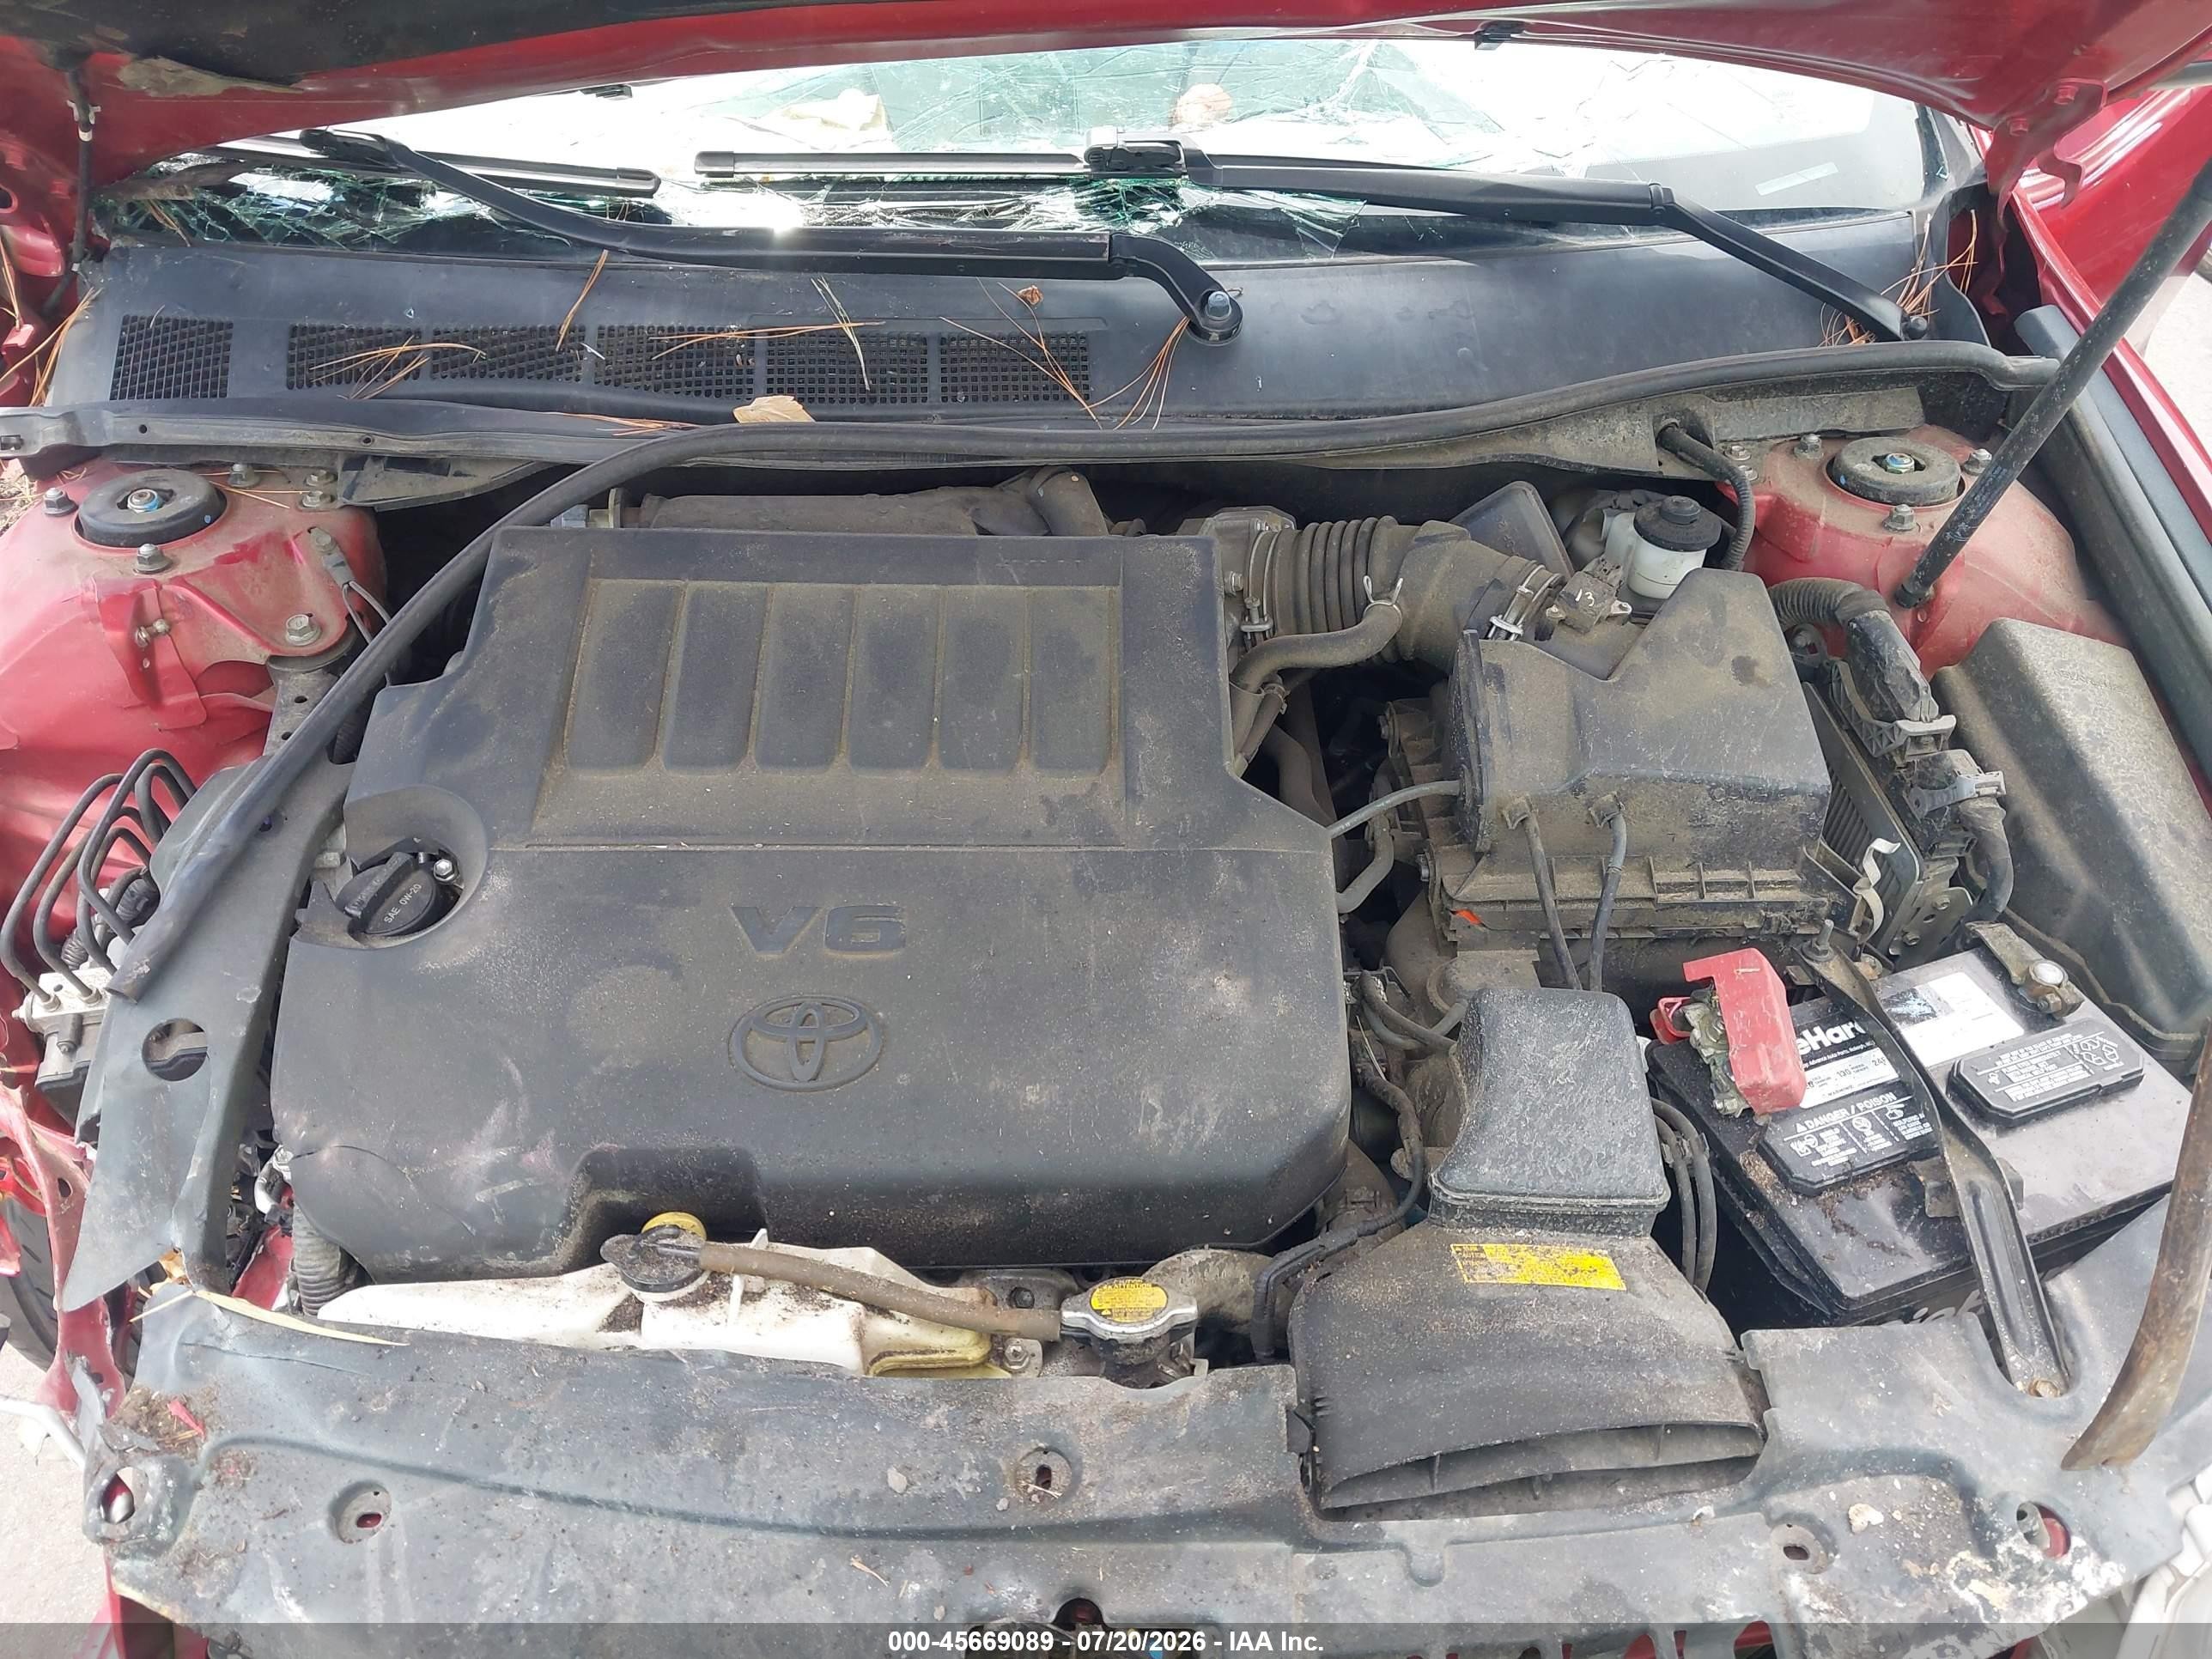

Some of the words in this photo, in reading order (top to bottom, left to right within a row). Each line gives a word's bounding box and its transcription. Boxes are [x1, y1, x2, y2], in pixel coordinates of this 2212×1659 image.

[384, 906, 400, 924] SAE
[399, 883, 422, 906] 0W-20
[729, 904, 907, 955] V6
[1805, 1108, 1850, 1128] DANGER
[1856, 1092, 1897, 1112] POISON
